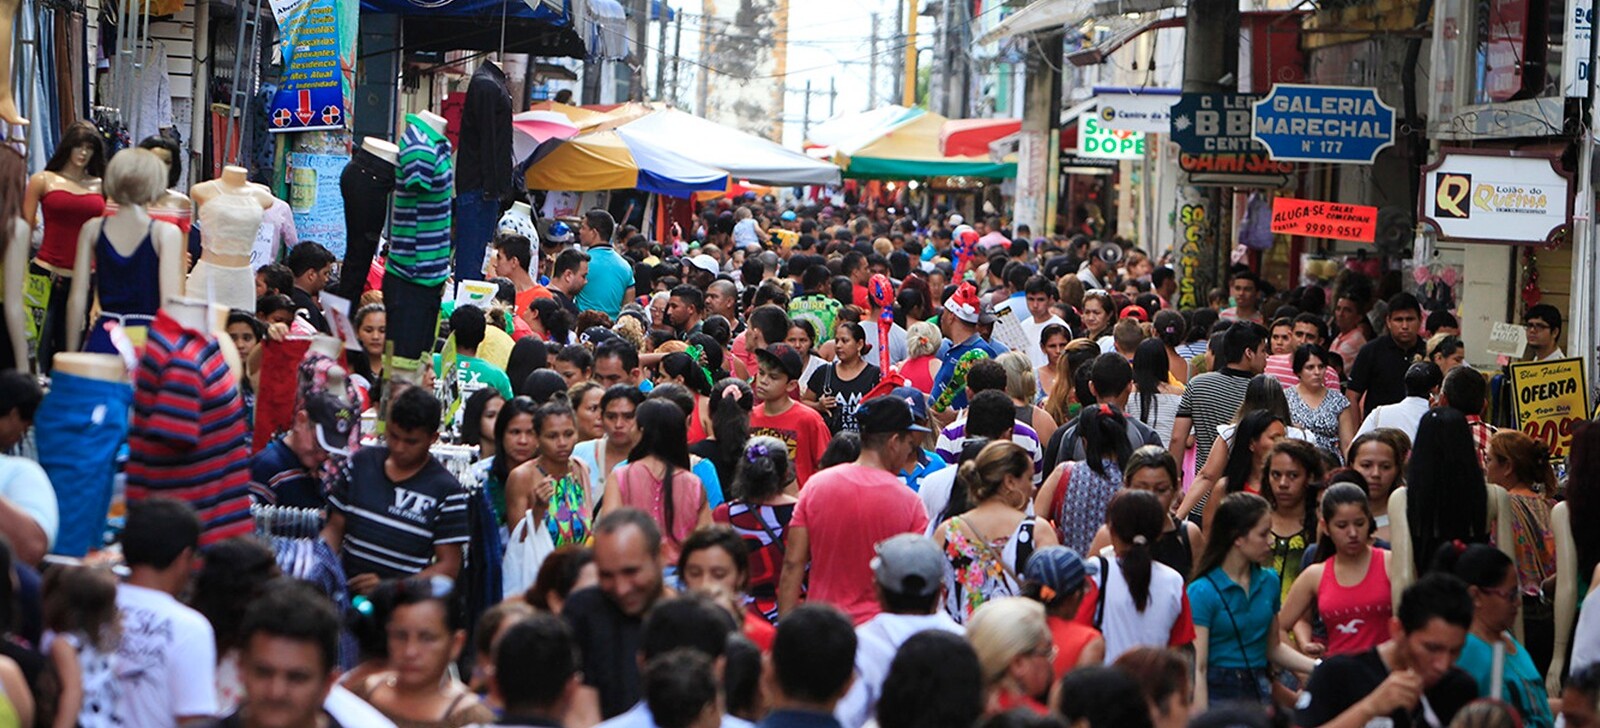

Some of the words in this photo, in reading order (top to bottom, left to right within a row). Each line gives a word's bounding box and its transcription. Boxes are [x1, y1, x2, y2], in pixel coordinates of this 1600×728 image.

[1273, 95, 1377, 116] GALERIA
[1256, 116, 1390, 139] MARECHAL
[1205, 137, 1267, 151] CENTE
[1320, 141, 1343, 154] 177
[1541, 366, 1572, 378] Fashion
[1521, 377, 1577, 404] OFERTA
[394, 487, 437, 515] VF
